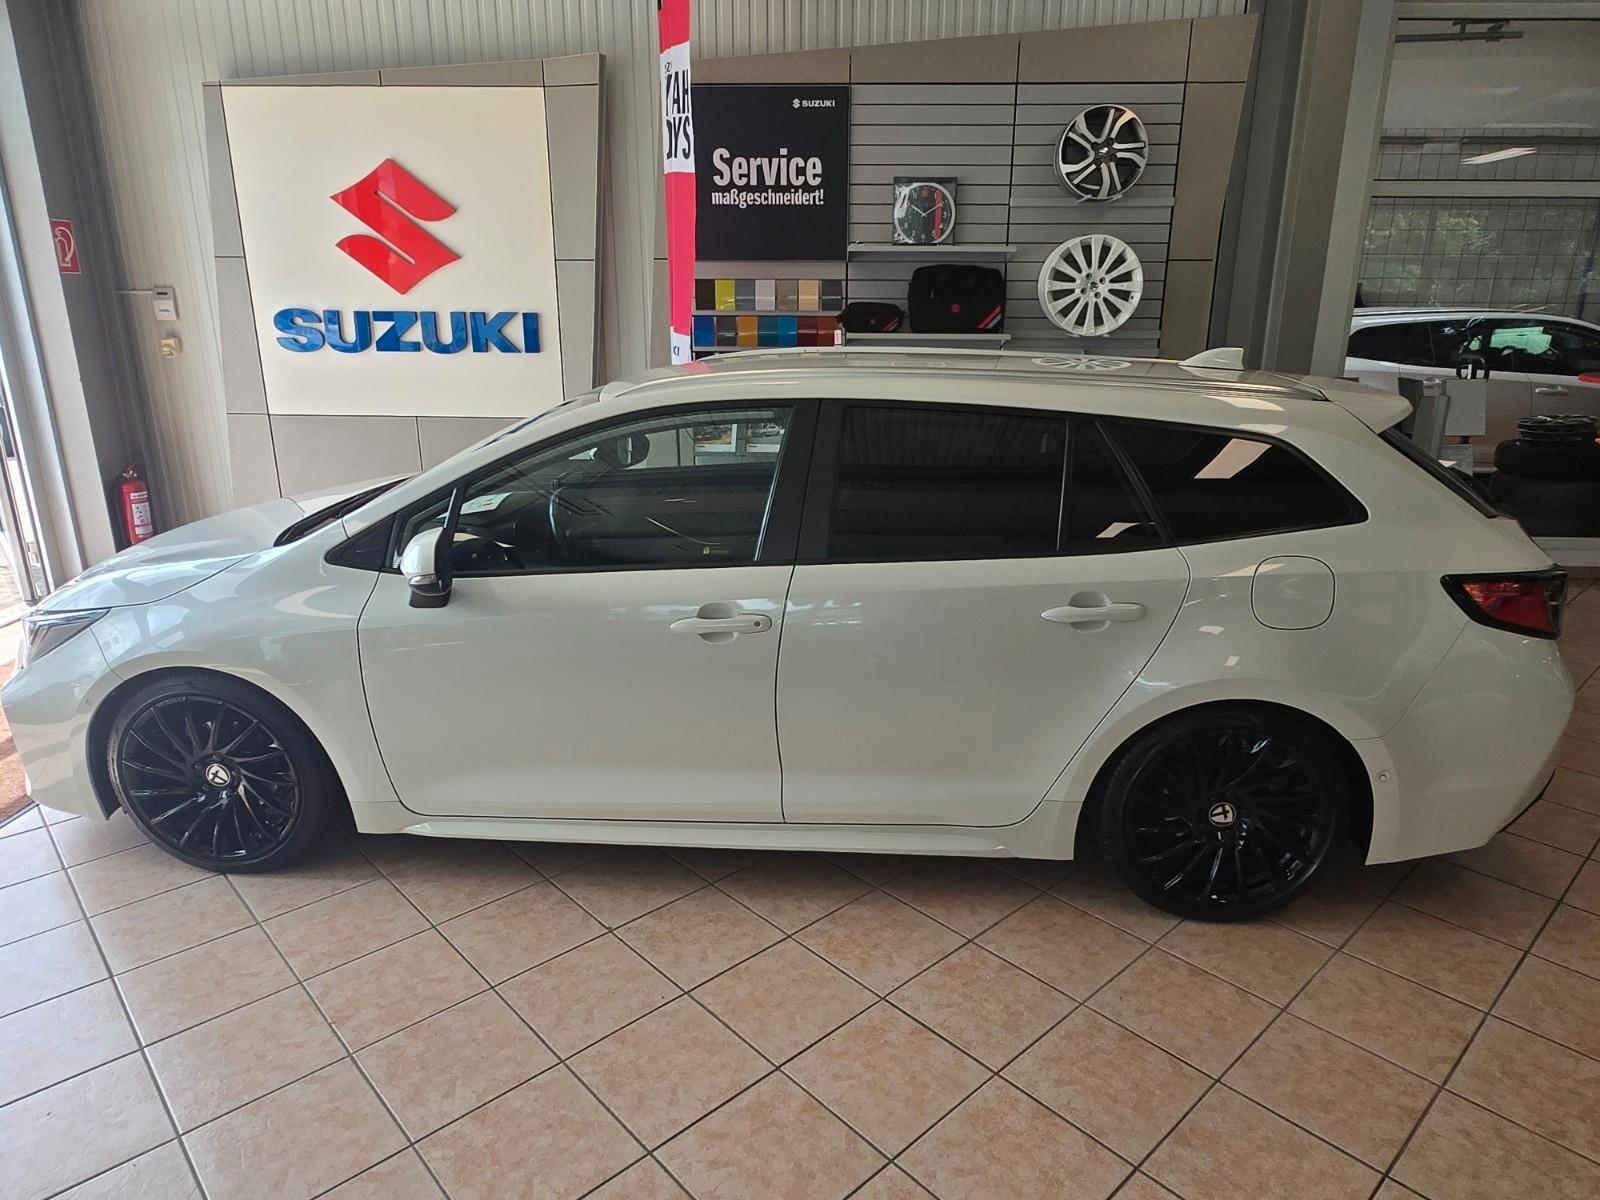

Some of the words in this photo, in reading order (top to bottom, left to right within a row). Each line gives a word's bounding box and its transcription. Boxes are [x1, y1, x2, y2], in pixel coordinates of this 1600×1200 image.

[801, 99, 836, 108] SUZUKI
[712, 147, 823, 187] Service
[711, 188, 825, 209] maßgeschneidert!
[273, 307, 543, 354] SUZUKI
